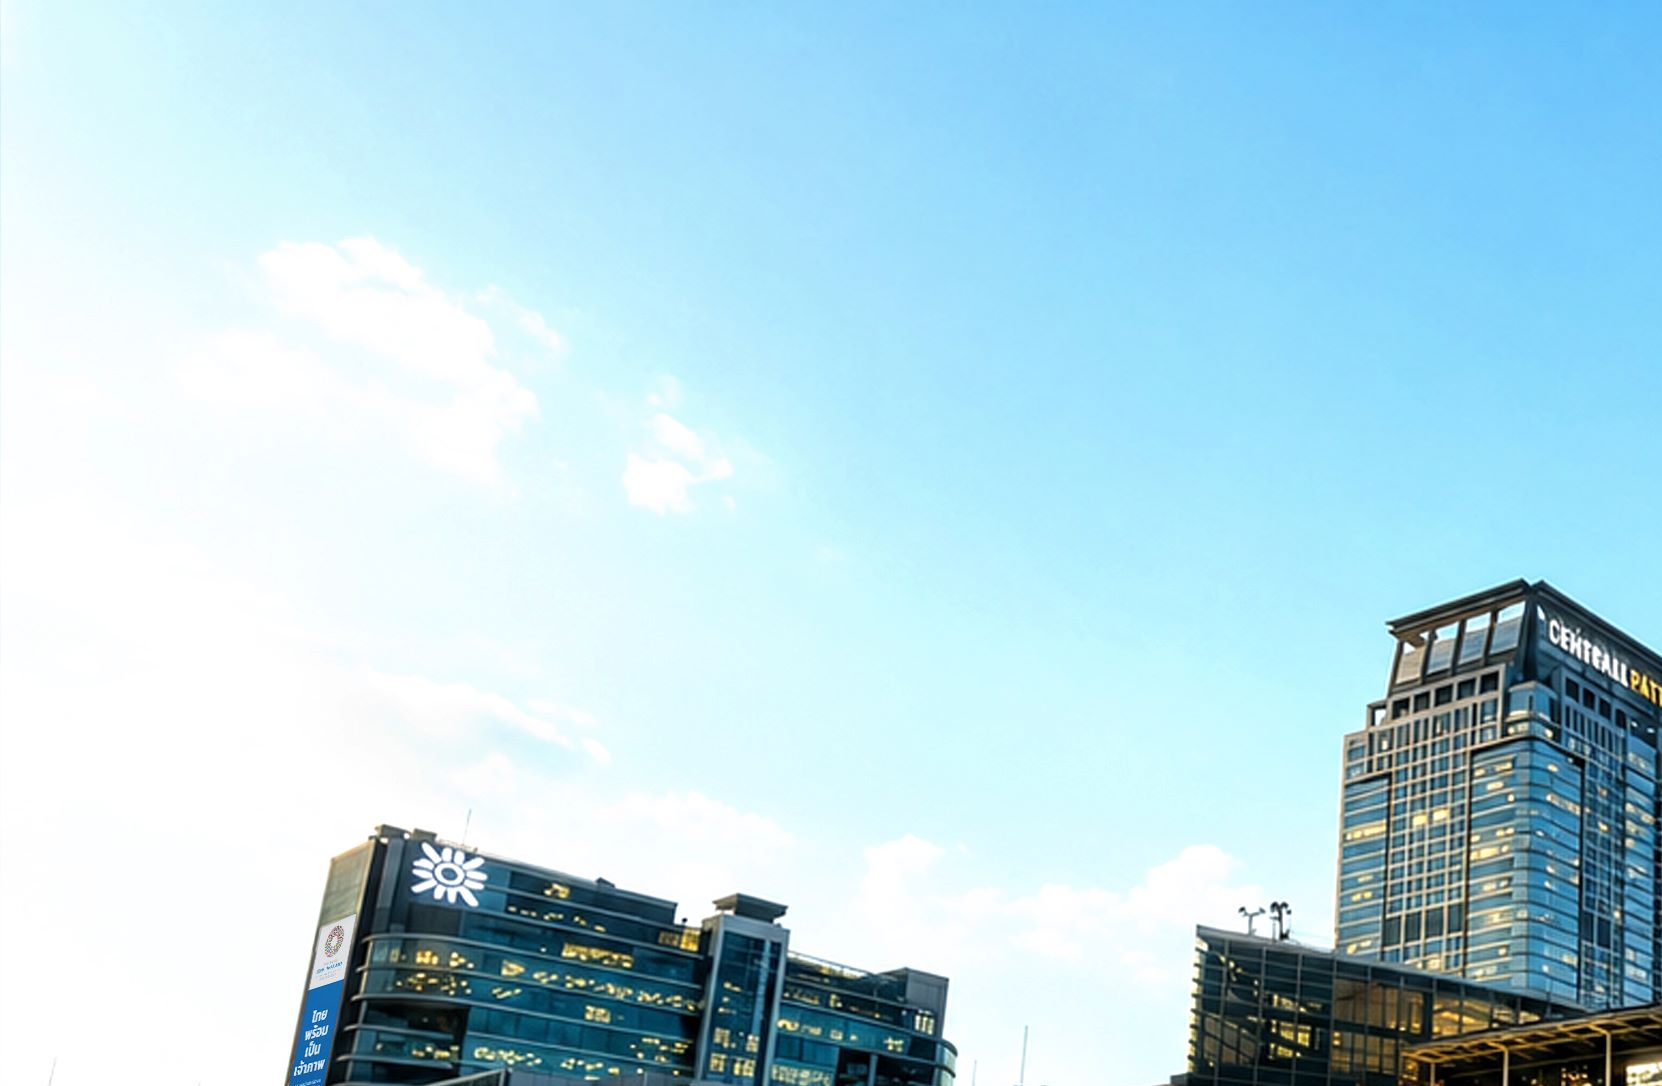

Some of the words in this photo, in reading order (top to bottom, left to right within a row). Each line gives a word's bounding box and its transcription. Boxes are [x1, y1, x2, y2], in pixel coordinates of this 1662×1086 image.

[311, 1009, 328, 1024] ไทย
[304, 1024, 329, 1041] พร้อม
[293, 1059, 326, 1077] เจ้าภาพ
